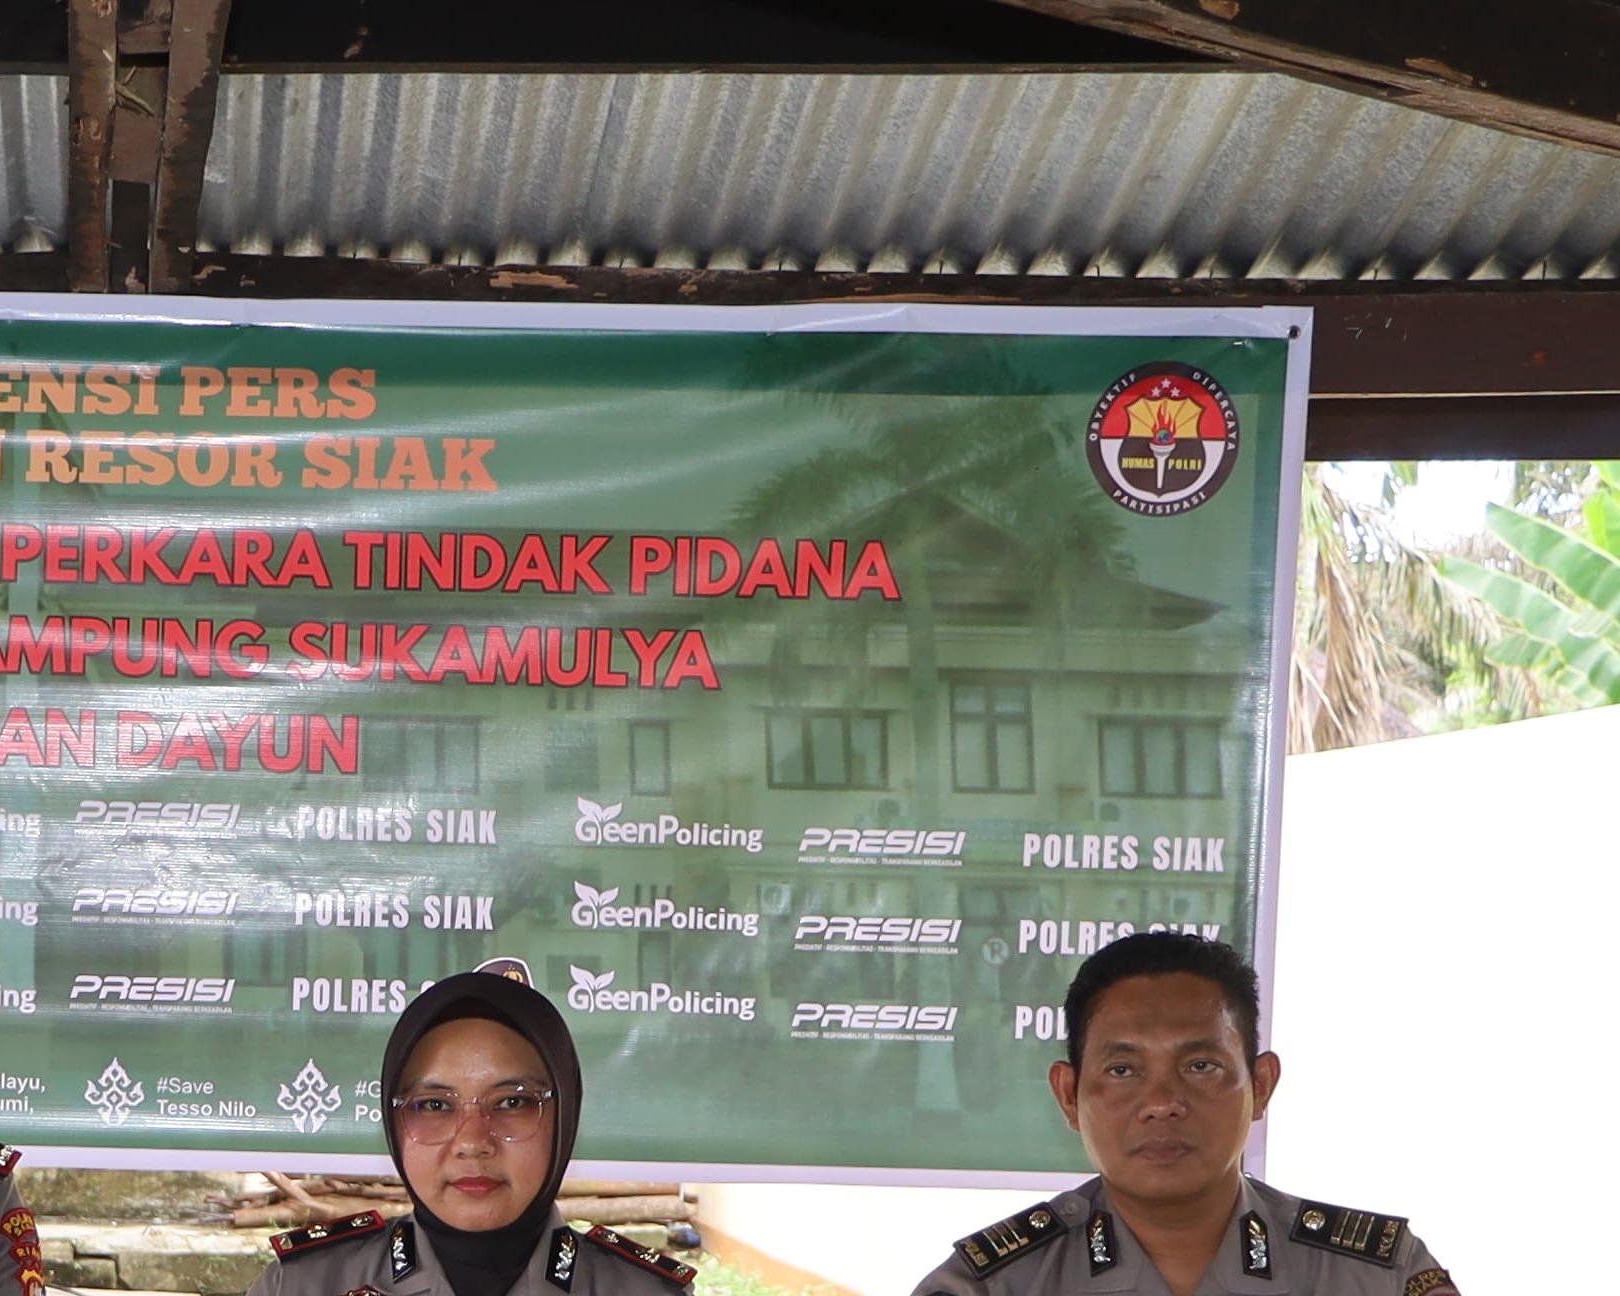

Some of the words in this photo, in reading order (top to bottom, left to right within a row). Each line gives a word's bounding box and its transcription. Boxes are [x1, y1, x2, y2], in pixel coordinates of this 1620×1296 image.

[180, 366, 377, 419] PERS
[1089, 373, 1136, 441] OBYEKTIF
[1192, 371, 1237, 450] DIPERCAYA
[25, 429, 282, 488] RESOR
[300, 436, 498, 492] SIAK
[1121, 457, 1155, 469] HUMAS
[1167, 458, 1202, 470] POLRI
[1112, 488, 1207, 515] PARTISIPASI
[0, 523, 332, 590] PERKARA
[342, 530, 613, 596] TINDAK
[629, 535, 902, 601] PIDANA
[286, 620, 721, 691] SUKAMULYA
[114, 706, 361, 774] DAYUN
[76, 800, 241, 829] PRESISI
[297, 805, 413, 843] POLRES
[426, 809, 497, 845] SIAK
[798, 828, 967, 856] PRESISI
[1023, 832, 1140, 871] POLRES
[1152, 836, 1225, 873] SIAK
[72, 889, 240, 916] PRESISI
[293, 892, 410, 930] POLRES
[423, 895, 495, 931] SIAK
[794, 915, 963, 944] PRESISI
[70, 975, 236, 1003] PRESISI
[292, 977, 407, 1014] POLRES
[791, 1003, 959, 1031] PRESISI
[1014, 1005, 1069, 1040] POL
[156, 1077, 214, 1095] #Save
[157, 1099, 213, 1116] Tesso
[218, 1101, 256, 1118] Nilo
